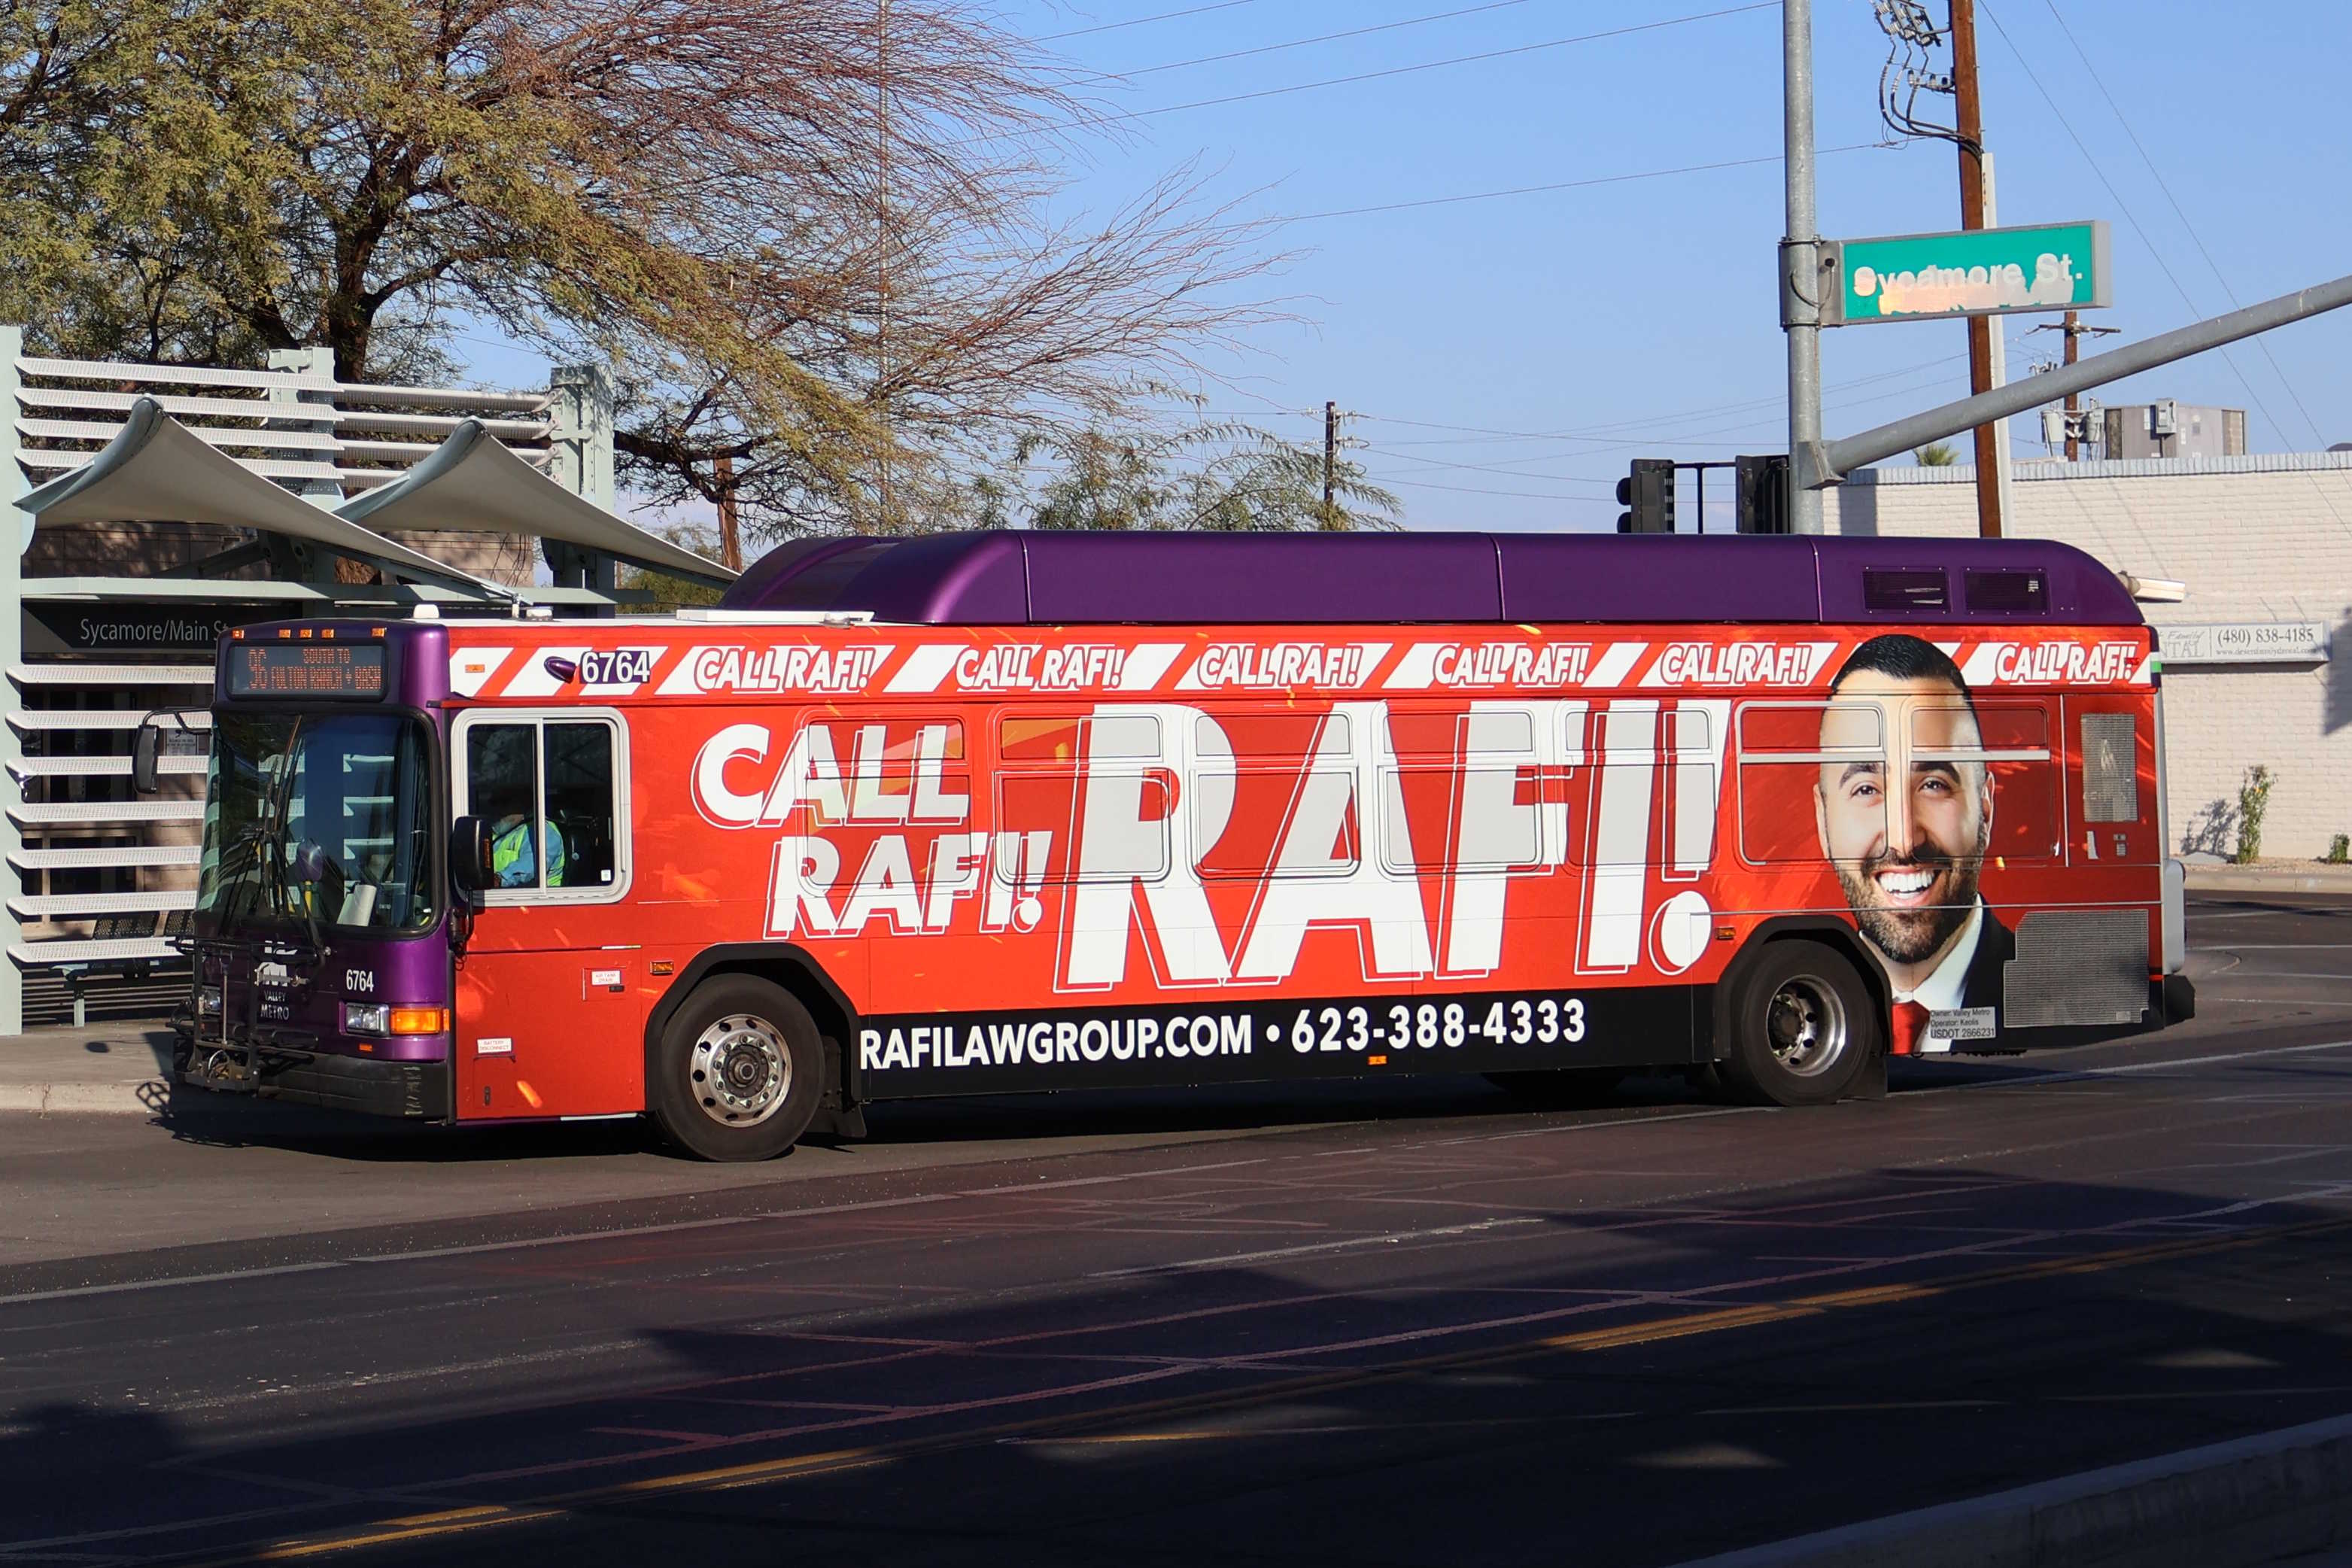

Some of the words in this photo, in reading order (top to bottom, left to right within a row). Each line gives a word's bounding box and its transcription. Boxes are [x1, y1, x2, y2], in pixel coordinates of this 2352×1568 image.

[1853, 263, 2025, 296] Sycamore
[2035, 253, 2083, 284] St.
[81, 618, 208, 646] Sycamore/Main
[2217, 629, 2251, 647] (480)
[2256, 628, 2314, 643] 838-4185
[302, 649, 335, 664] SOUTH
[337, 649, 351, 664] TO
[581, 652, 651, 683] 6764
[697, 649, 785, 690] CALL
[786, 649, 873, 688] RAFI!
[956, 648, 1035, 688] CALL
[1041, 649, 1125, 687] RAFI!
[1199, 646, 1275, 686] CALL
[1278, 647, 1362, 686] RAFI!
[1435, 646, 1506, 684] CALL
[1512, 647, 1590, 683] RAFI!
[1661, 646, 1731, 683] CALL
[1735, 646, 1810, 683] RAFI!
[1996, 646, 2062, 681] CALL
[271, 667, 308, 689] FULTON
[310, 666, 343, 689] RANCH
[691, 723, 970, 829] CALL
[1053, 699, 1732, 993] RAFI!
[764, 830, 1053, 940] RAFI!
[264, 990, 286, 1002] VALLEY
[346, 969, 374, 992] 6764
[260, 1004, 290, 1020] METRO
[860, 1013, 1253, 1071] RAFILAWGROUP.COM
[1291, 998, 1587, 1053] 623-388-4333
[1931, 1029, 1959, 1038] USDOT
[1962, 1028, 1995, 1038] 2866231
